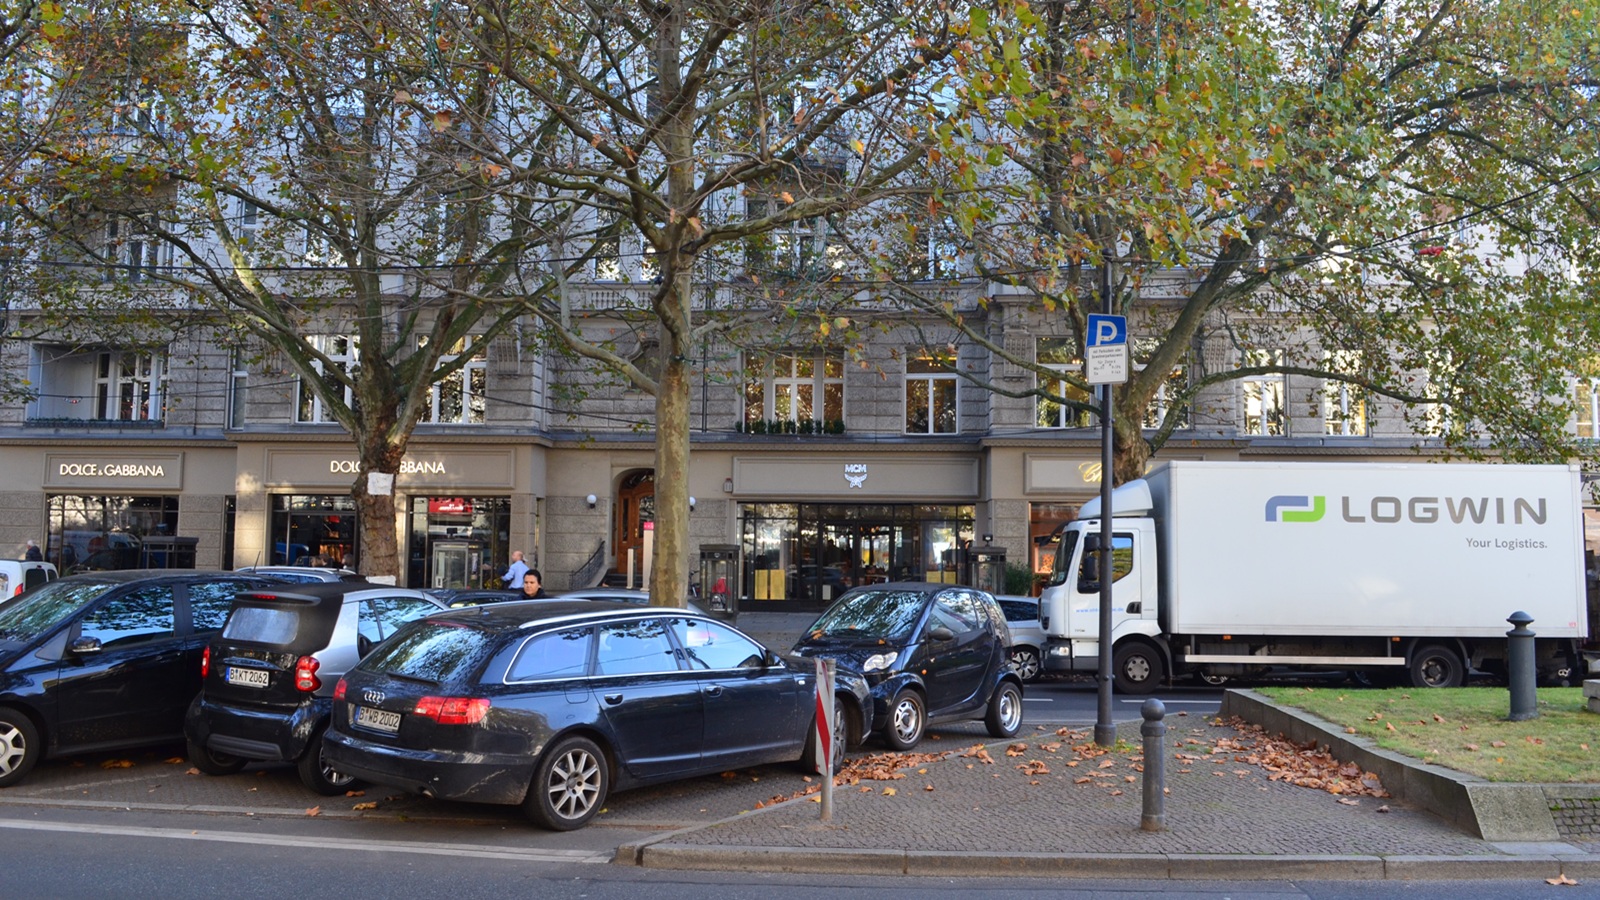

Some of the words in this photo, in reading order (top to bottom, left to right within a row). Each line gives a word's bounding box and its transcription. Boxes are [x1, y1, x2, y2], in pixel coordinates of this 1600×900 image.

[1095, 320, 1118, 346] P
[59, 463, 98, 476] DOLCE
[104, 464, 165, 477] GABBANA
[399, 461, 446, 474] BBANA
[844, 463, 867, 473] MCM
[1341, 496, 1548, 525] LOGWIN
[1465, 537, 1492, 548] Your
[1494, 538, 1548, 551] Logistics.
